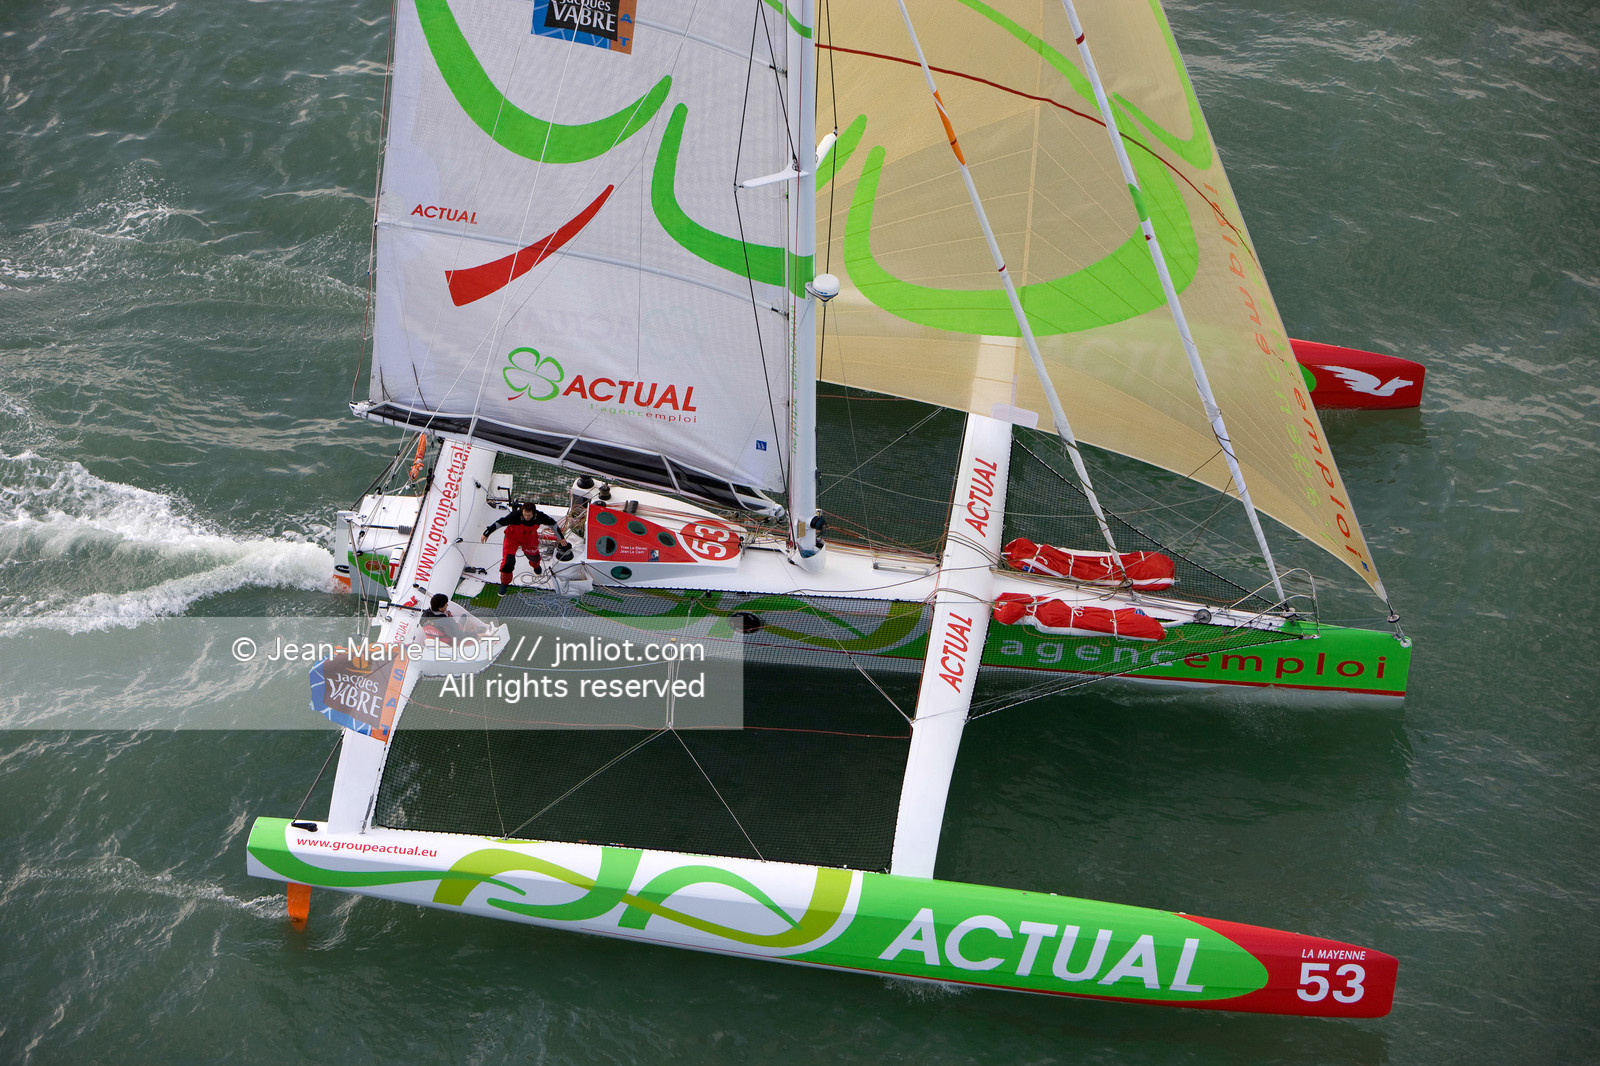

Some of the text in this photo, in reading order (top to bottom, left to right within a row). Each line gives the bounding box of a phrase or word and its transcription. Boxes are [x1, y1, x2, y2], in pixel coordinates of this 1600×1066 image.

[552, 0, 617, 32] VABRE
[410, 203, 477, 225] ACTUAL
[562, 374, 697, 412] ACTUAL
[965, 457, 998, 538] ACTUAL
[691, 525, 730, 558] 53
[939, 612, 972, 693] ACTUAL
[327, 678, 382, 718] VABRE
[335, 673, 379, 694] Jacques
[296, 836, 438, 858] www.groupeactual.eu
[877, 907, 1205, 993] ACTUAL
[1301, 949, 1366, 960] LA MAYENNE
[1296, 962, 1366, 1004] 53
